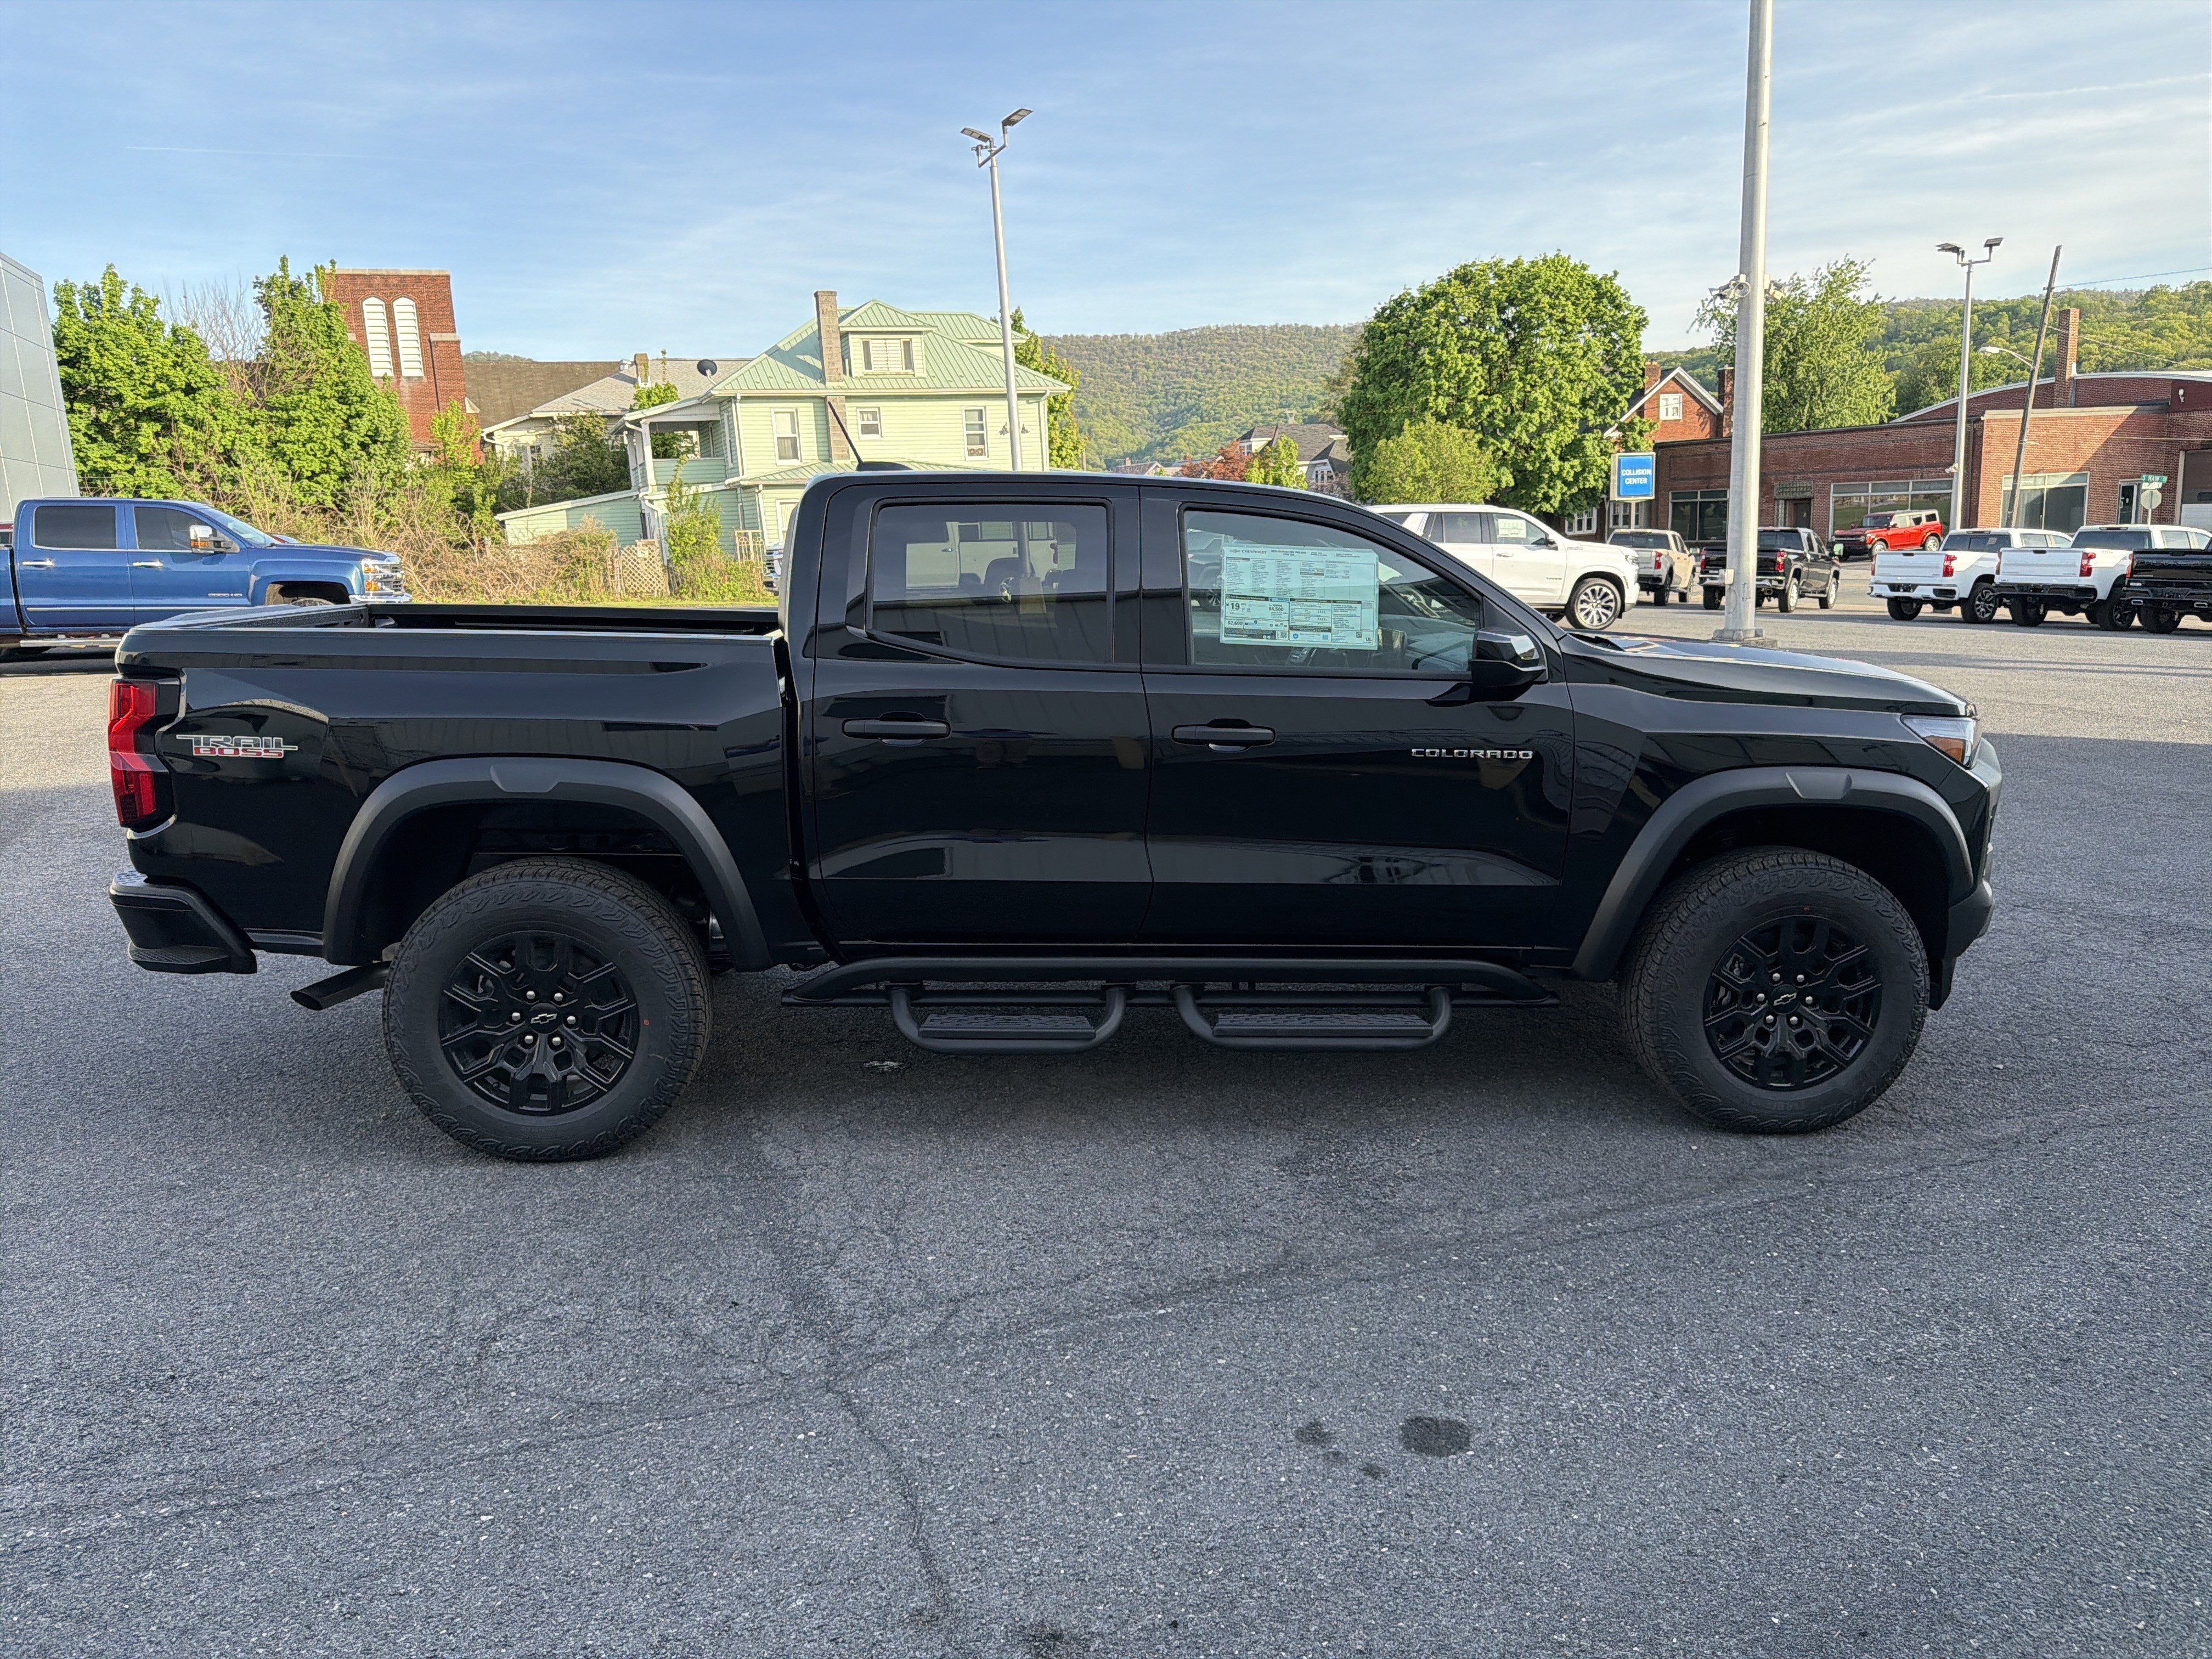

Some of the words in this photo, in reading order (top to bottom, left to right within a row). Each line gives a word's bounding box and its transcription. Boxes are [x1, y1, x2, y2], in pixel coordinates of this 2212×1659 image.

[176, 735, 298, 751] TRAIL
[193, 747, 284, 758] BOSS
[1412, 748, 1533, 759] COLORADO
